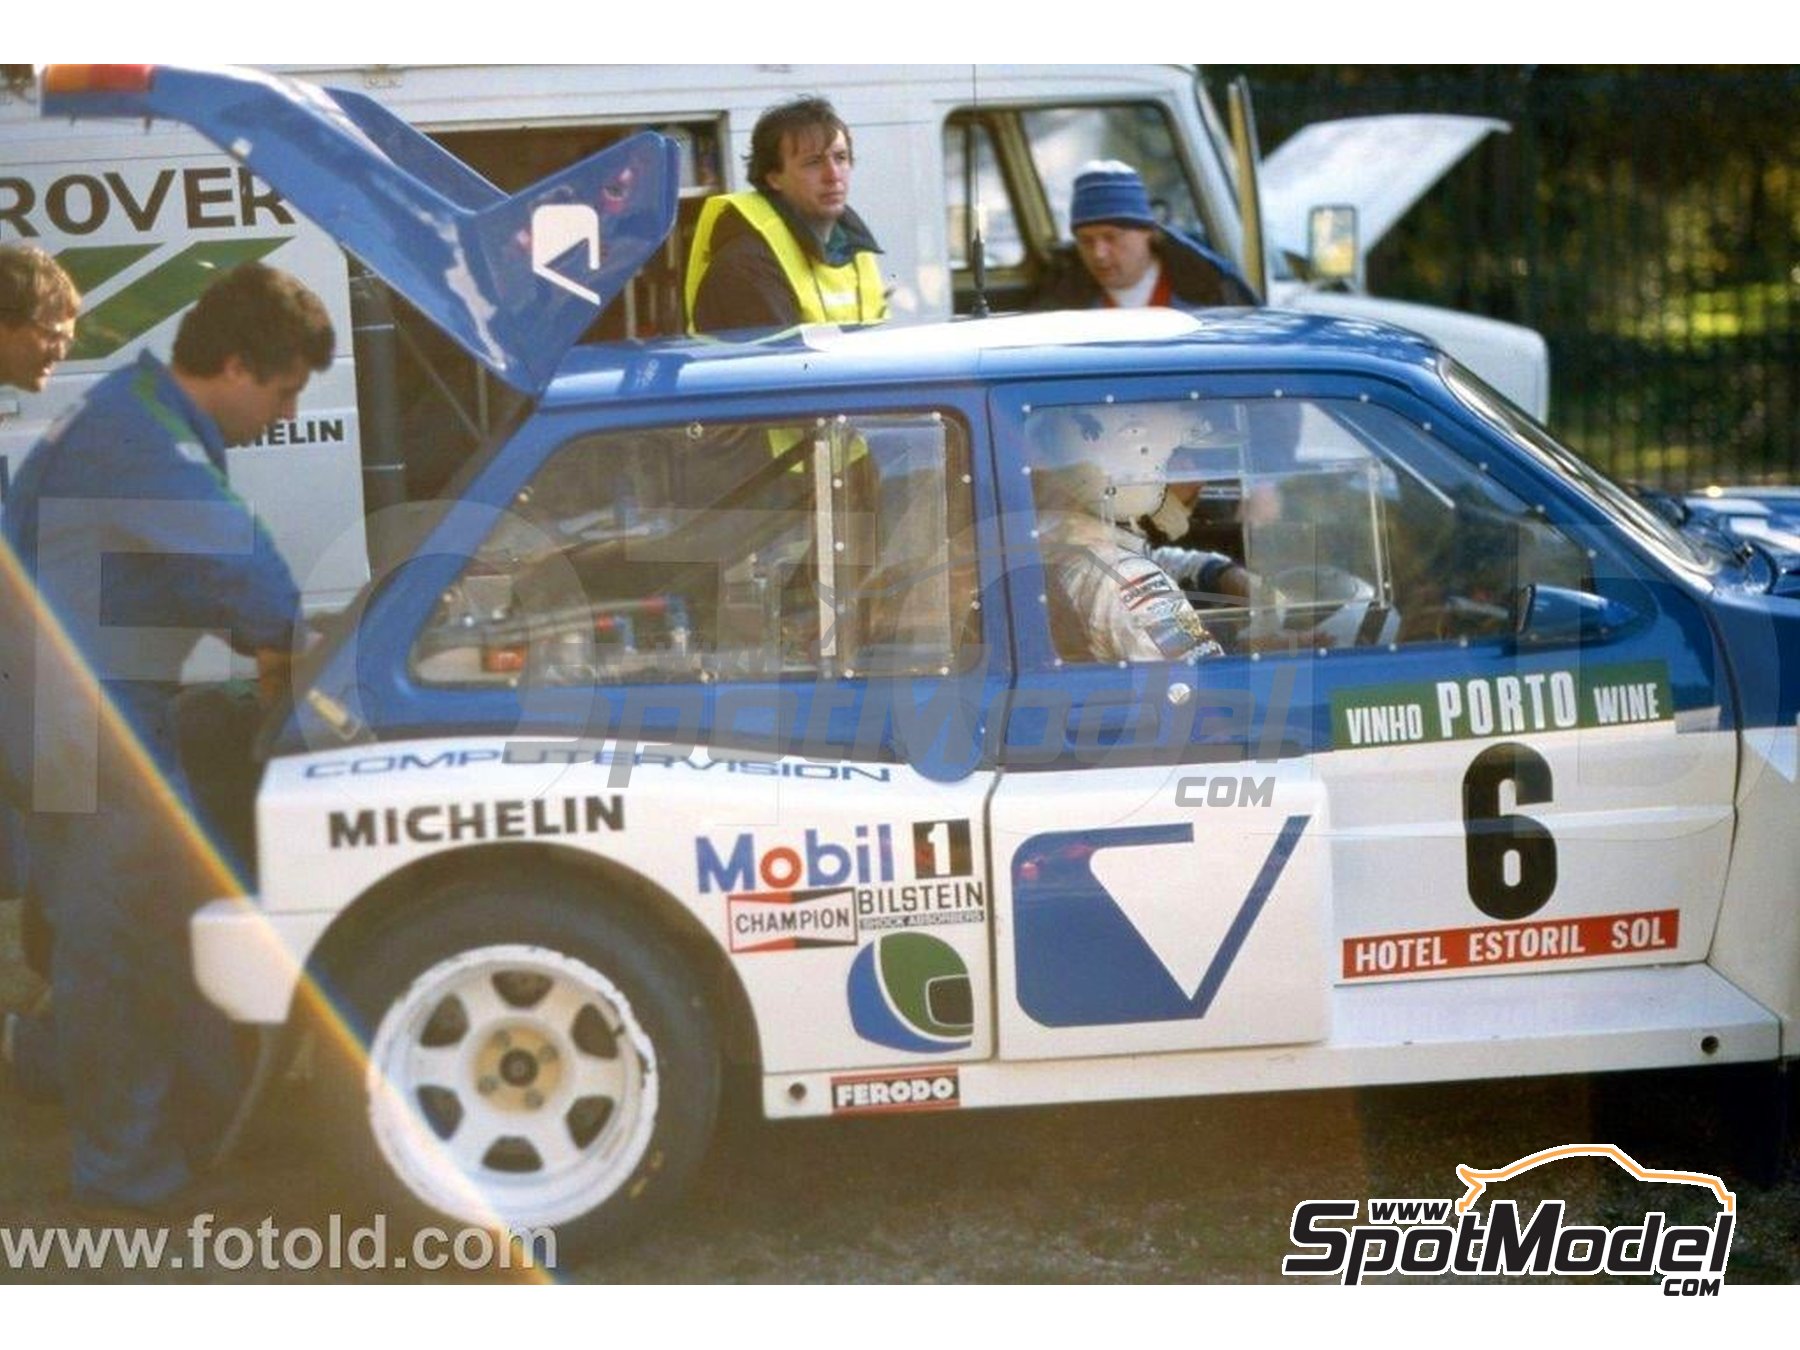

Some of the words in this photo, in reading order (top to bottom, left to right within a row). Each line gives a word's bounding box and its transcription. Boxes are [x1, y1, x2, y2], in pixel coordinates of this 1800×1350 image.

[1345, 703, 1424, 745] VINHO
[1436, 670, 1578, 738] PORTO
[1593, 682, 1661, 725] WINE
[304, 749, 891, 783] COMPUTERVISION
[329, 795, 625, 848] MICHELIN
[1462, 741, 1558, 921] 6
[695, 823, 894, 894] Mobil
[735, 907, 850, 934] CHAMPION
[858, 882, 984, 915] BILSTEIN
[1355, 936, 1448, 972] HOTEL
[1468, 924, 1586, 962] ESTORIL
[1610, 916, 1666, 949] SOL
[836, 1077, 955, 1106] FERODO
